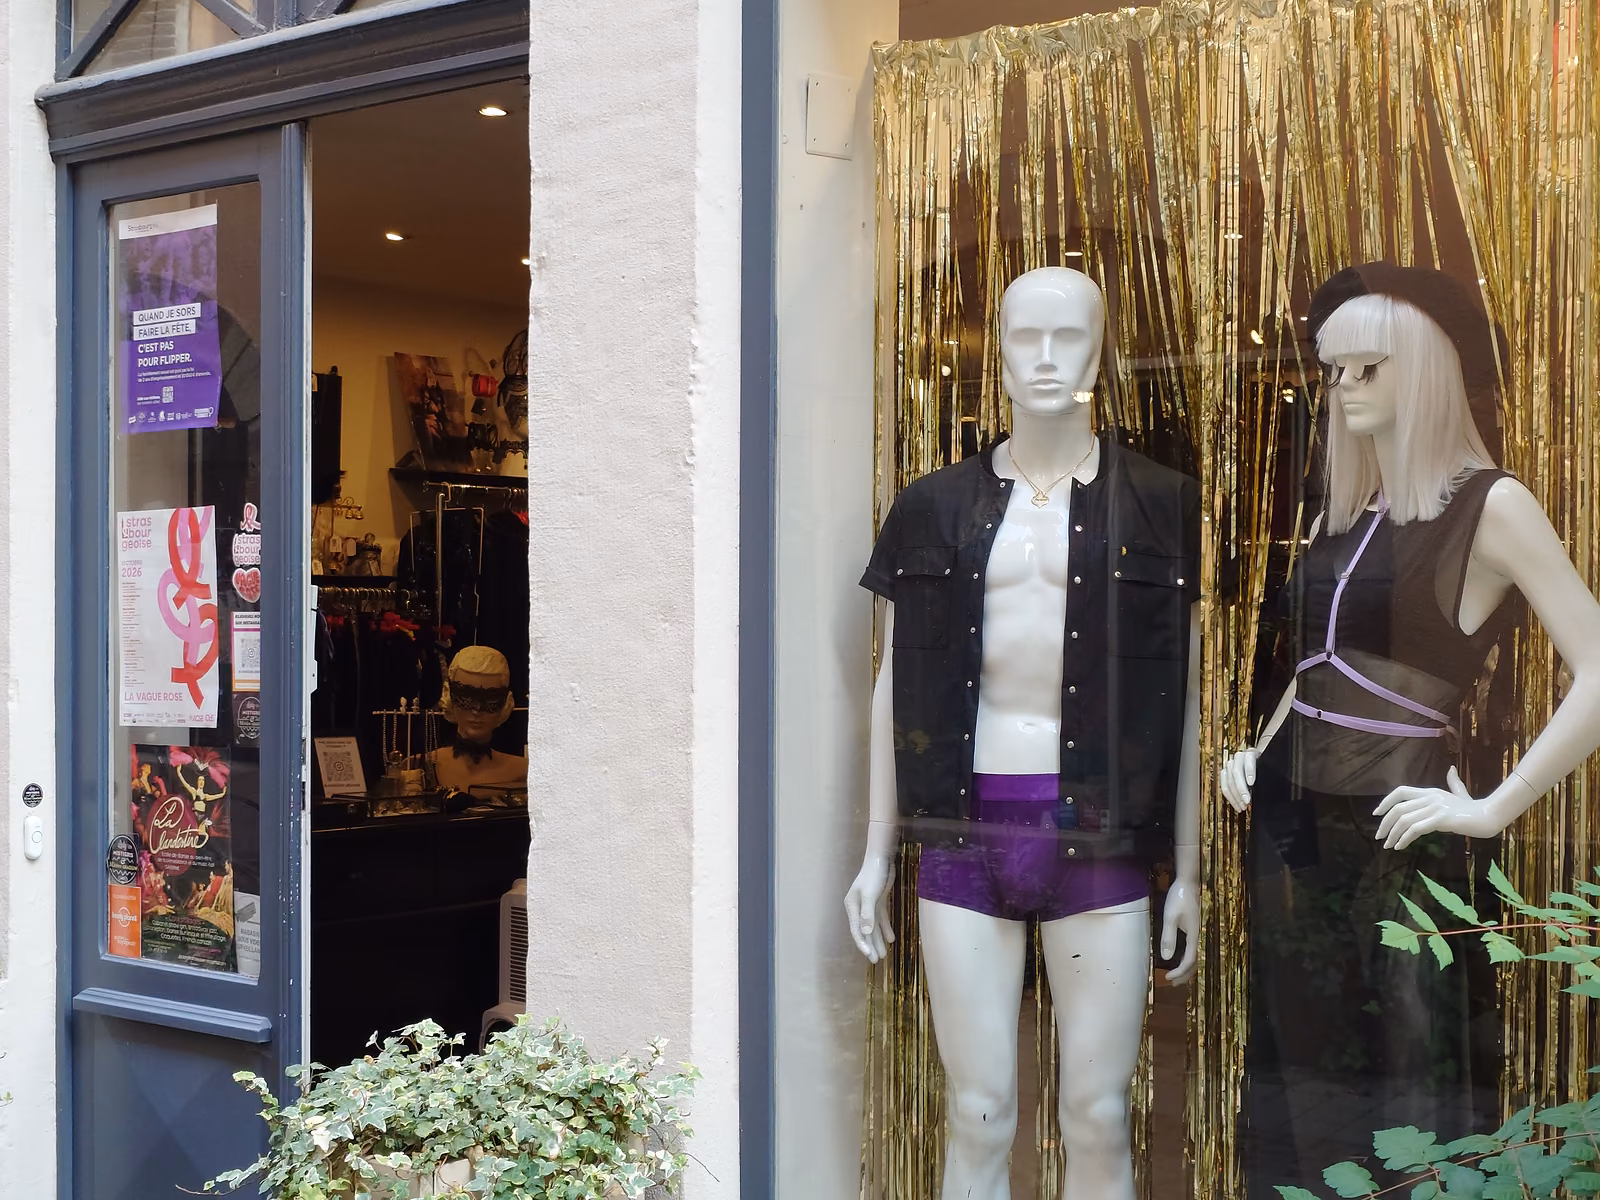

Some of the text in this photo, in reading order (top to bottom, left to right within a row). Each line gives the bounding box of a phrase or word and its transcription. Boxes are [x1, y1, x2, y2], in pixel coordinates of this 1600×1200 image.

[138, 306, 196, 322] QUAND JE SORS
[139, 322, 191, 337] FAIRE LA FÊTE,
[138, 341, 174, 353] C'EST PAS
[138, 353, 192, 368] POUR FLIPPER.
[122, 539, 152, 552] geoise
[121, 567, 143, 578] 2026
[124, 692, 183, 701] LA VAGUE ROSE
[154, 801, 178, 829] La
